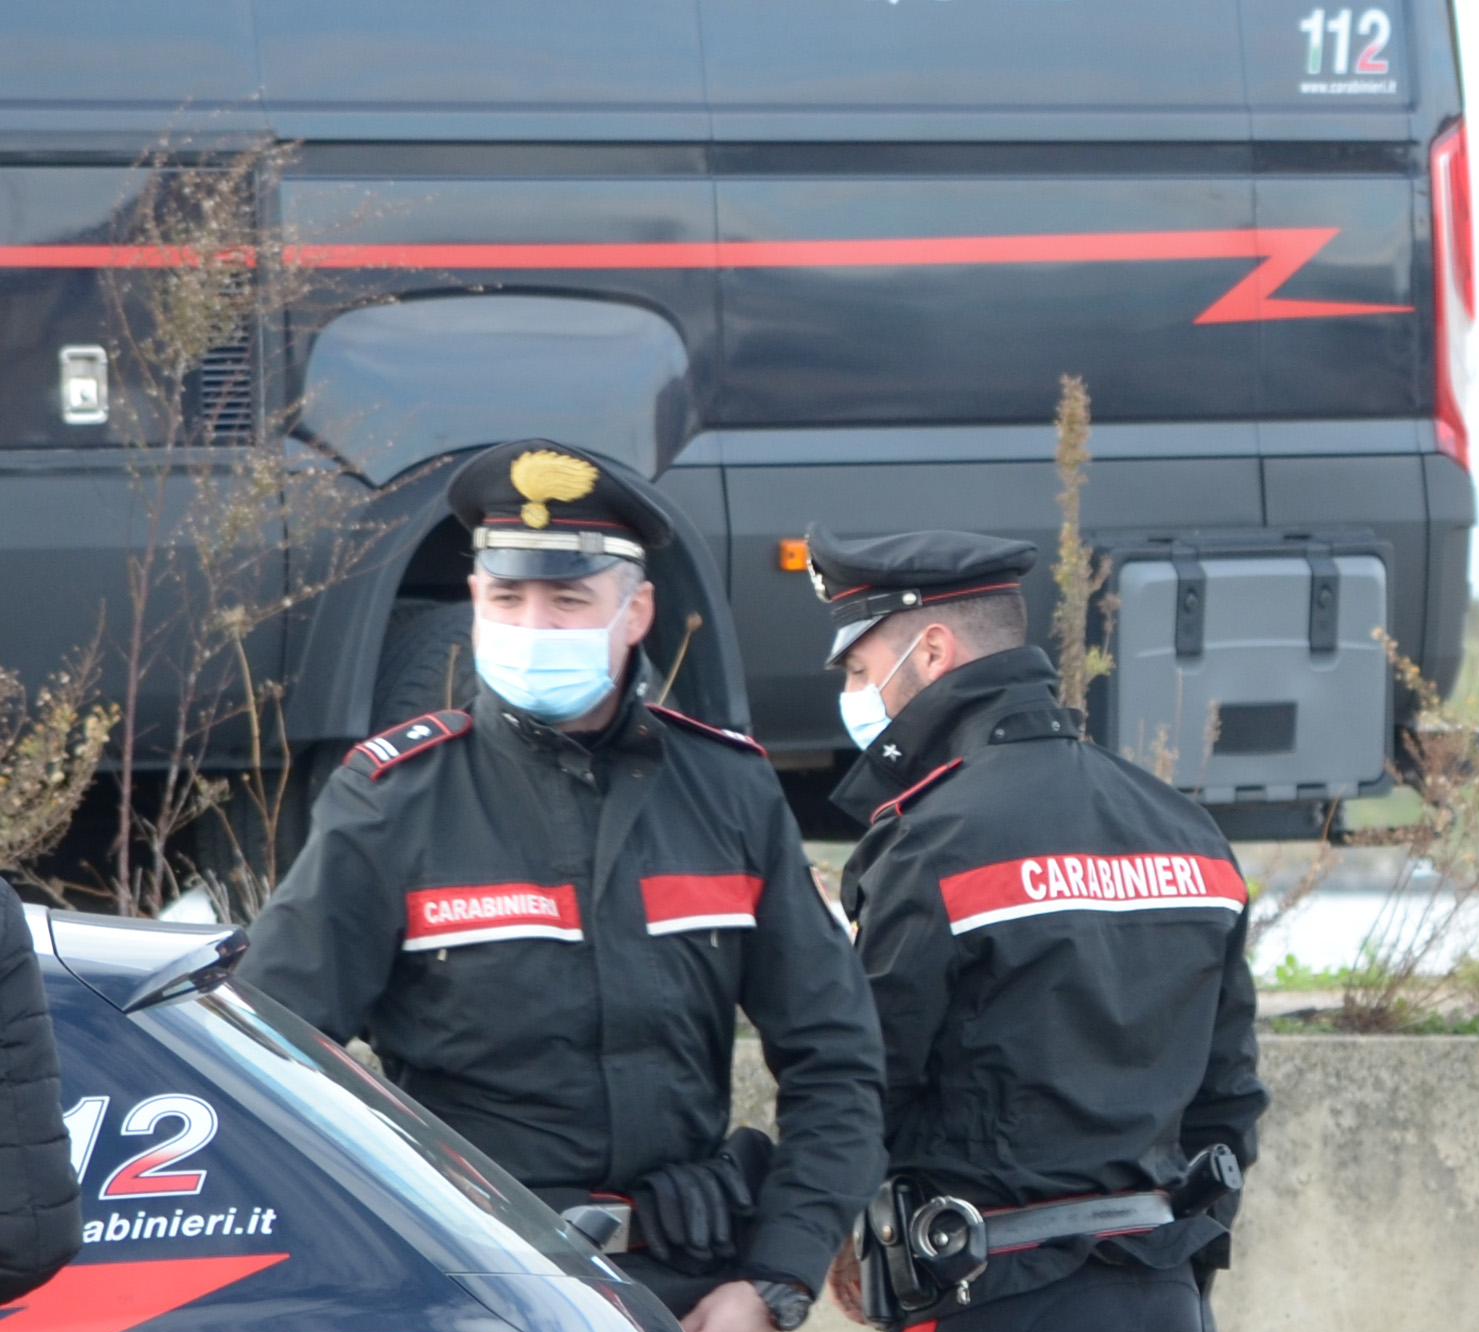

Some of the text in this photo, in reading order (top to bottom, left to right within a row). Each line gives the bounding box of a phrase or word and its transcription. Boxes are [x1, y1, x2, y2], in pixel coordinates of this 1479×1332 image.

[1299, 8, 1390, 74] 112
[1021, 857, 1206, 900] CARABINIERI
[424, 894, 560, 924] CARABINIERI
